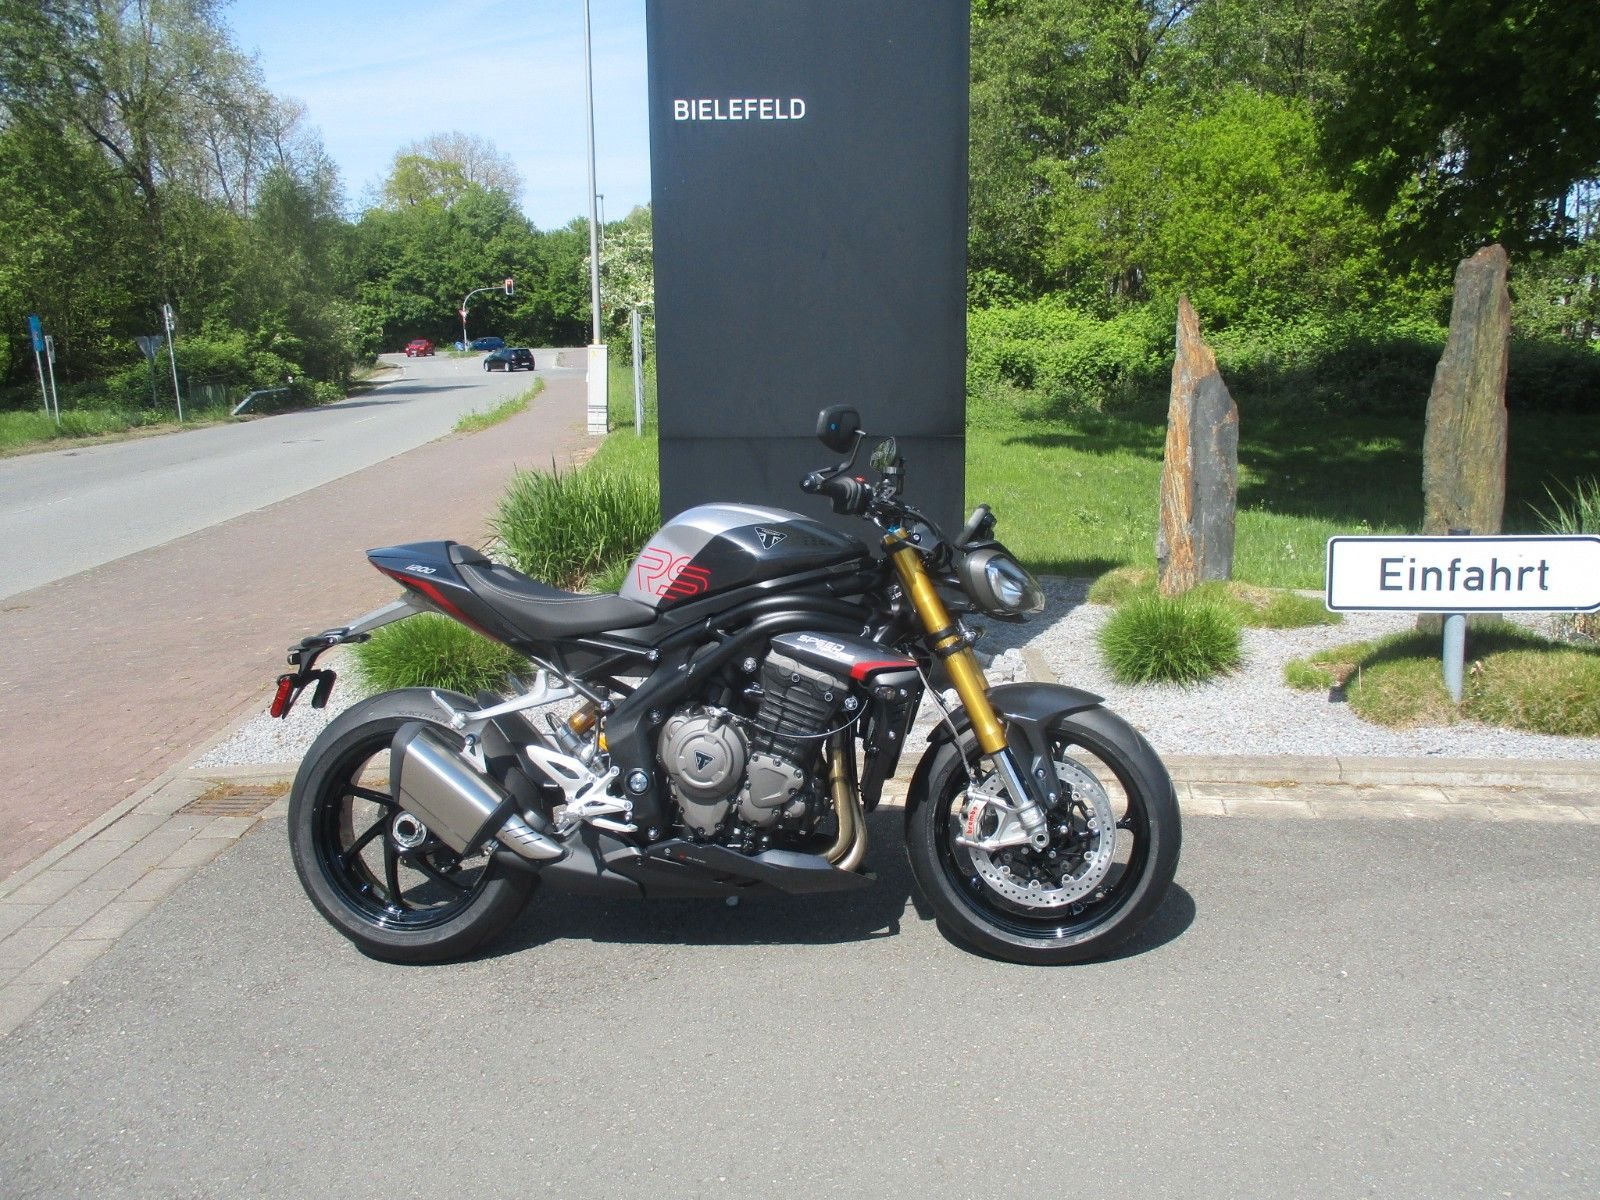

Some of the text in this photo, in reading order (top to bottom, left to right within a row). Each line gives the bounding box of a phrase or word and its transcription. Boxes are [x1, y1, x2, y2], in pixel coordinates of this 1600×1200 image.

[674, 98, 806, 120] BIELEFELD
[637, 547, 712, 600] RS
[1379, 557, 1549, 591] Einfahrt
[797, 634, 846, 653] SPEED
[966, 806, 978, 834] brembo
